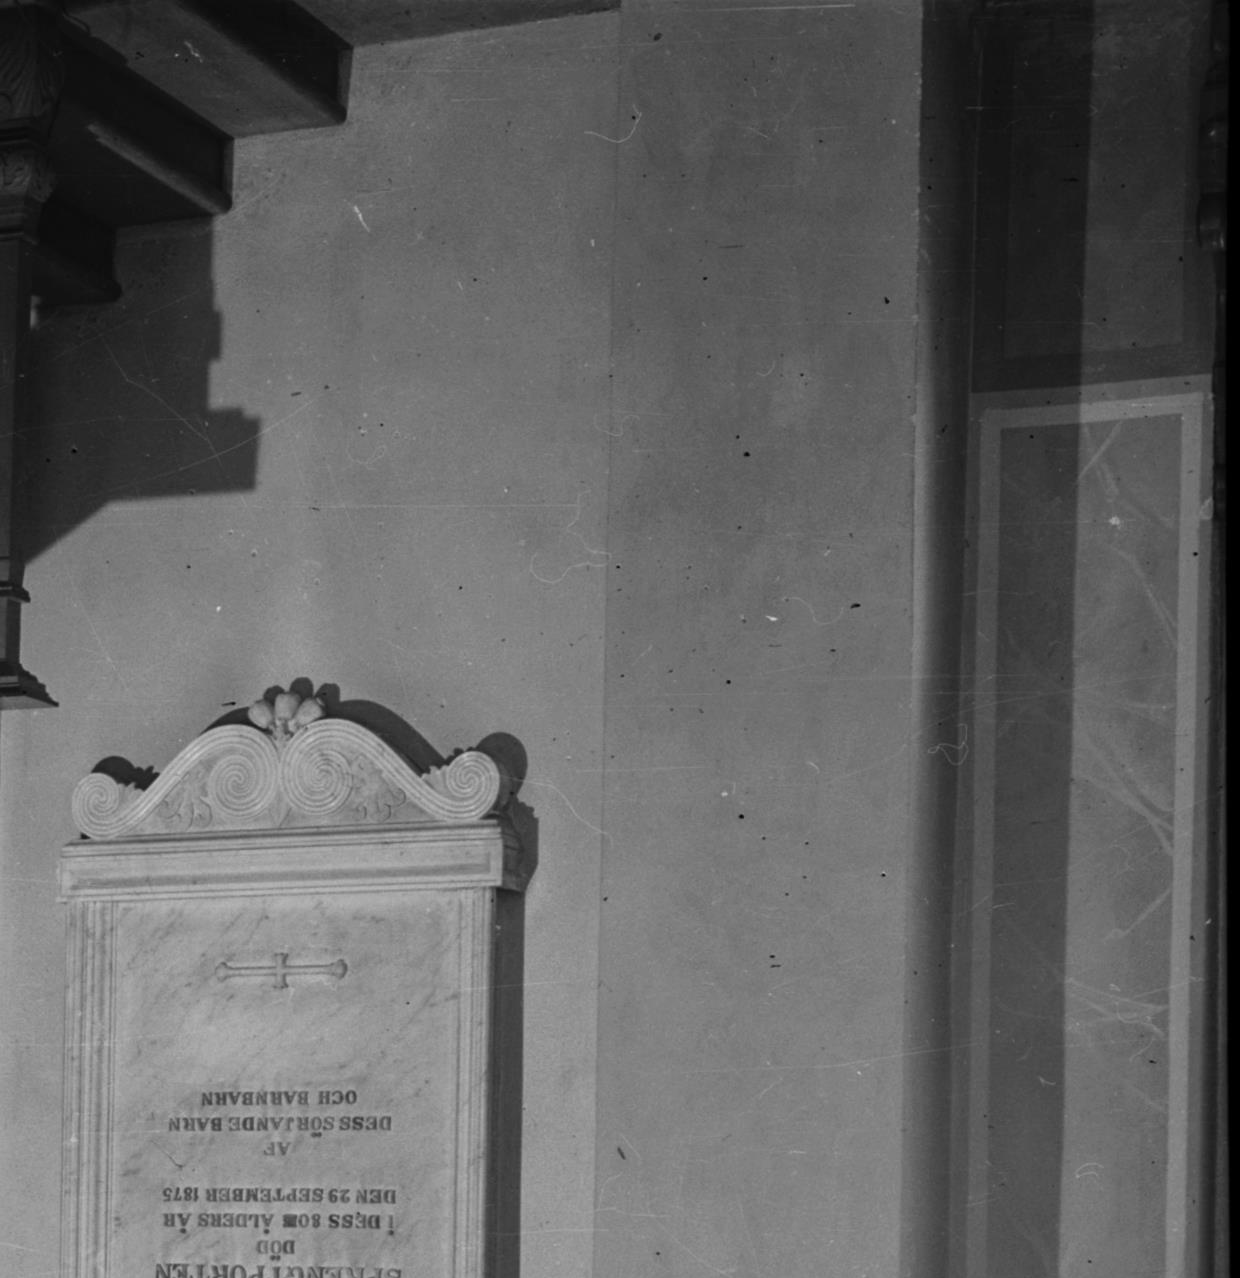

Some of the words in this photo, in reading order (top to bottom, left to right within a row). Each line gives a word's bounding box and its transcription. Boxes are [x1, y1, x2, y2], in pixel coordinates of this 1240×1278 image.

[200, 1091, 308, 1106] BARNBARN
[318, 1090, 357, 1105] OCH
[168, 1117, 222, 1132] BARN
[228, 1116, 335, 1138] SÖRJANDE
[339, 1116, 392, 1131] DESS
[263, 1141, 290, 1156] AF
[162, 1187, 199, 1201] 1875
[206, 1188, 324, 1202] SEPTEMBER
[329, 1188, 350, 1203] 29
[356, 1189, 397, 1204] DEN
[163, 1213, 191, 1234] ÅR
[198, 1213, 274, 1234] ÅLDERS
[328, 1214, 381, 1229] DESS
[256, 1240, 295, 1261] DÖD
